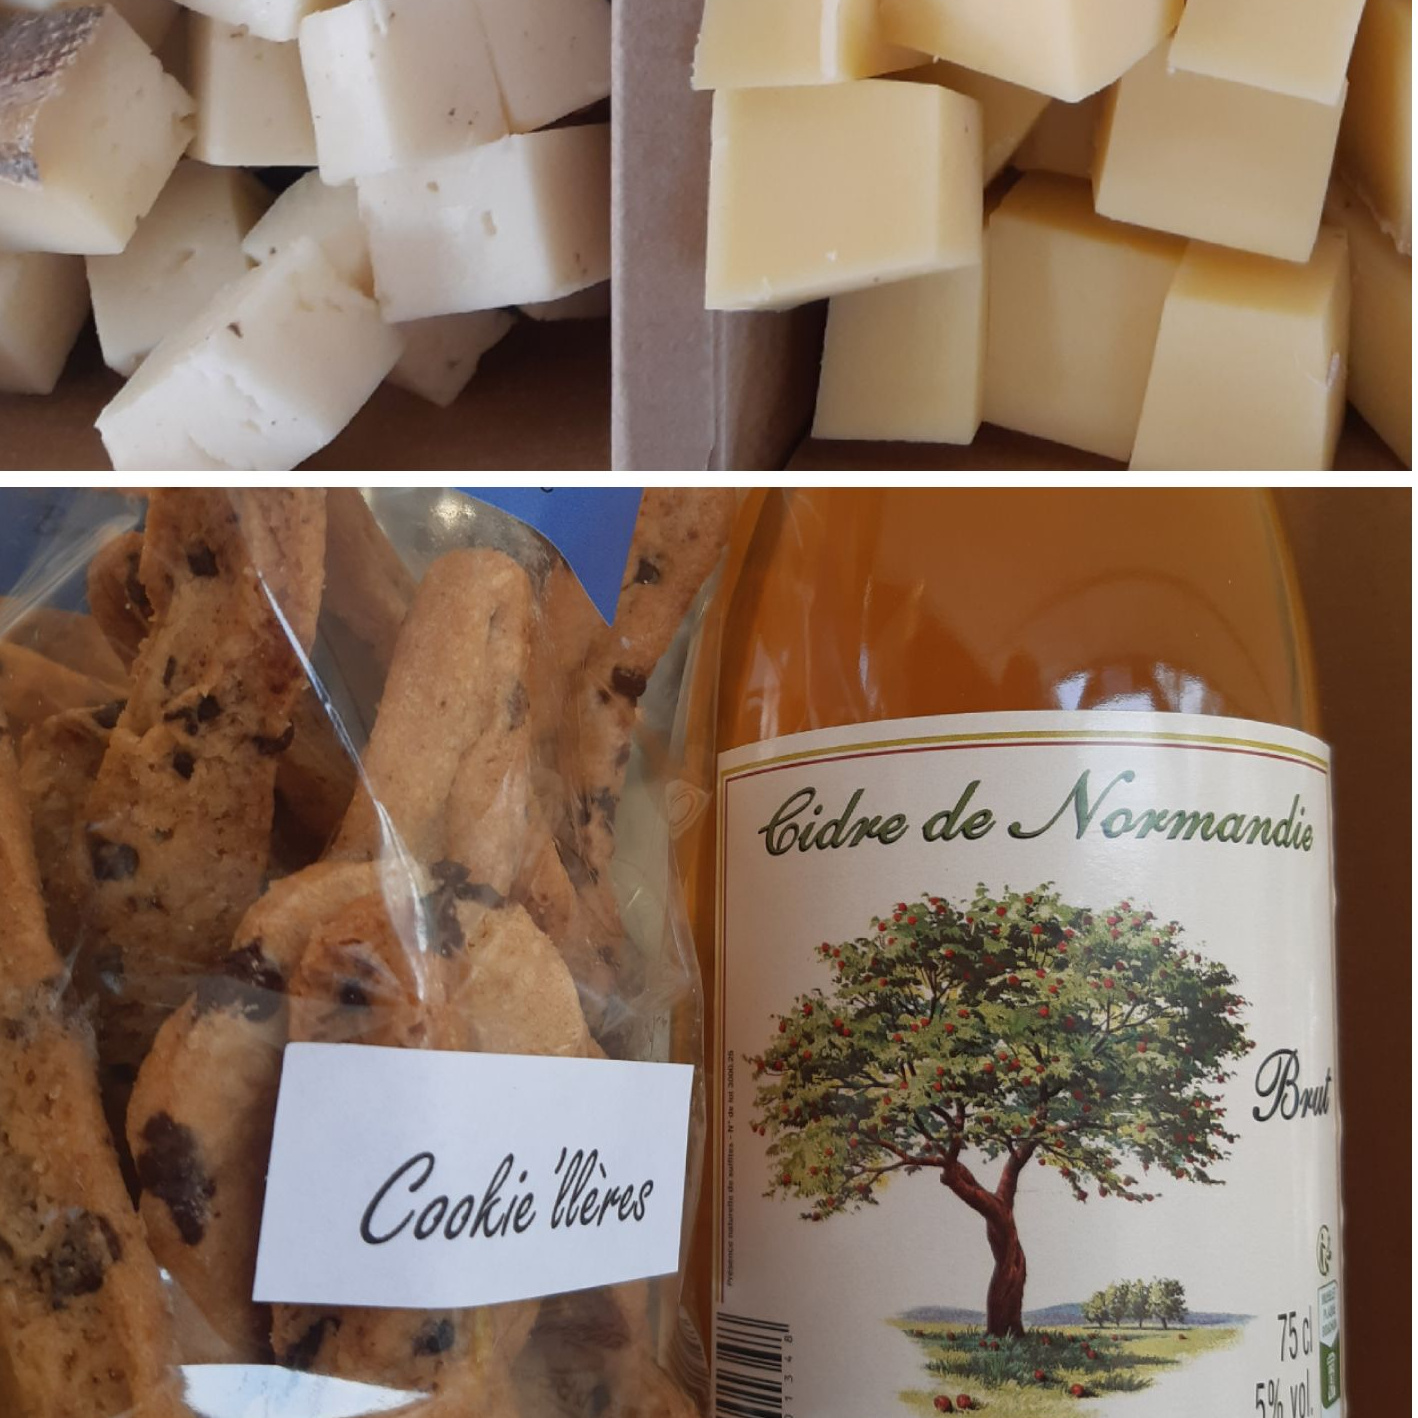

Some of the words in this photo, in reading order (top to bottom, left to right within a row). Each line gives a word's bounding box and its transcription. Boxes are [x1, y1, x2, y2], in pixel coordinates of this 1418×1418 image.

[758, 786, 908, 857] Cidre
[921, 779, 997, 843] de
[1010, 768, 1314, 853] Normandie
[1252, 1048, 1332, 1122] Brut
[1277, 1311, 1299, 1362] 75
[1301, 1305, 1313, 1356] cl
